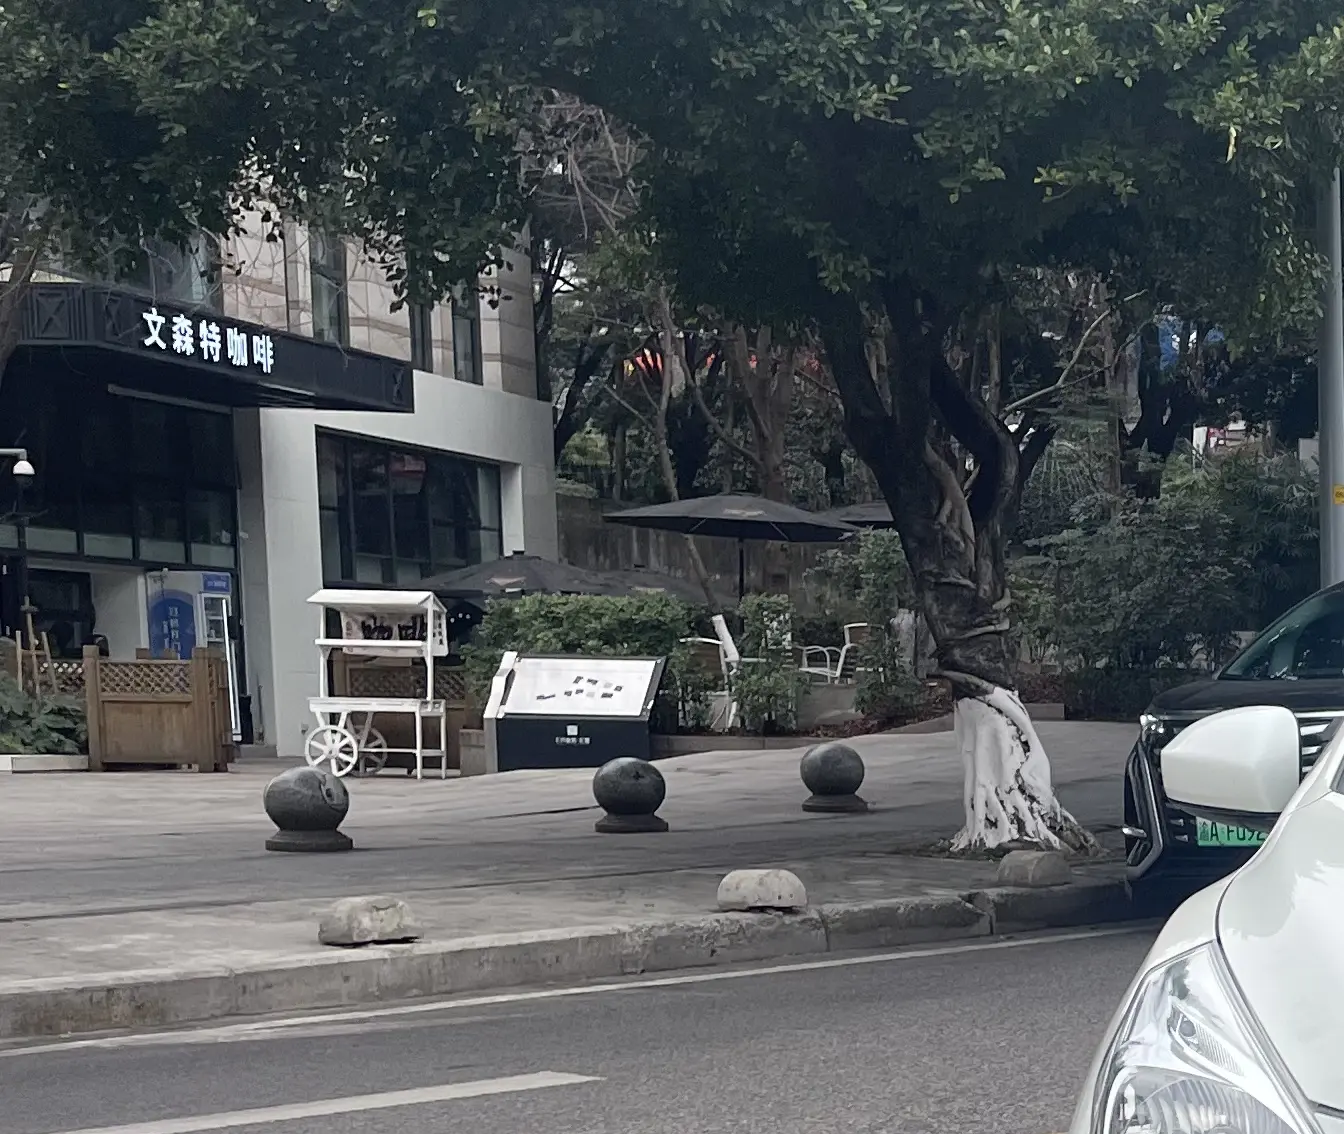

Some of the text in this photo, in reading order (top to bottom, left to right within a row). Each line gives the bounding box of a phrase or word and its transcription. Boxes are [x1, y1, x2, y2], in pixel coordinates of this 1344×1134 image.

[142, 307, 275, 374] 文森特咖啡
